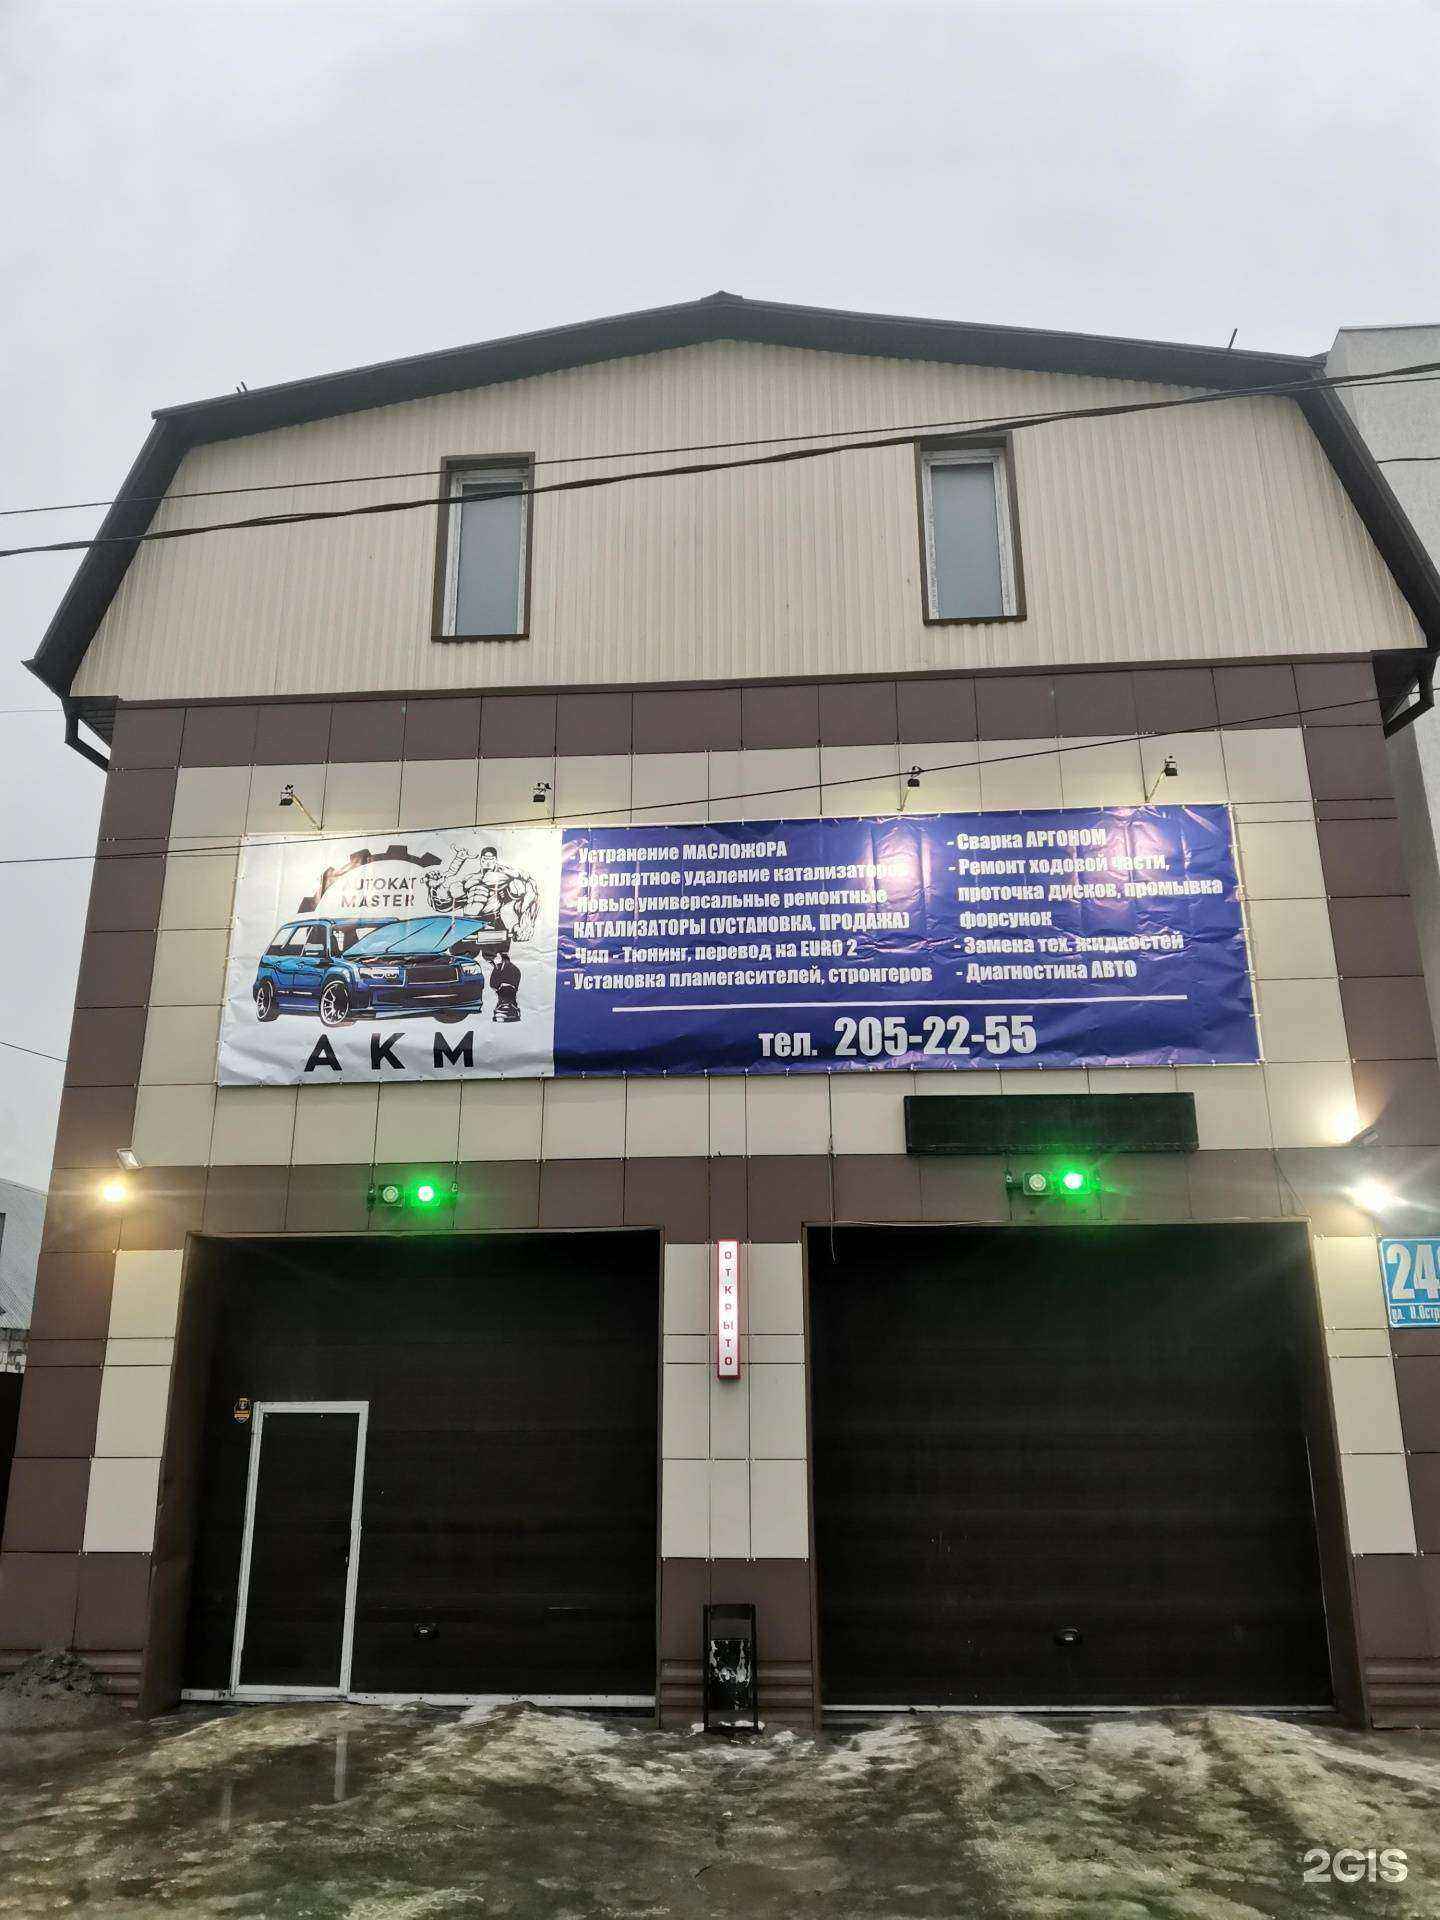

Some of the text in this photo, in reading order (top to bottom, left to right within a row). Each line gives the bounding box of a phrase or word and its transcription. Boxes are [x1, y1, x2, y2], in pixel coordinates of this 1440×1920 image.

[957, 833, 1023, 850] Сварка
[1026, 828, 1106, 847] АРГОНОМ
[578, 847, 679, 863] Устранение
[682, 841, 787, 860] МАСЛОЖОРА
[958, 858, 1026, 875] Ремонт
[1029, 853, 1108, 875] ходовой
[1114, 854, 1170, 871] части,
[684, 866, 770, 886] удаление
[341, 894, 415, 908] MASTER
[577, 896, 635, 913] Новые
[637, 890, 780, 912] универсальные
[784, 889, 888, 909] ремонтные
[958, 879, 1223, 902] проточка дисков, промывка
[573, 911, 911, 939] КАТАЛИЗАТОРЫ (УСТАНОВКА, ПРОДАЖА)
[960, 911, 1053, 930] форсунок
[575, 947, 609, 964] Чип
[622, 946, 692, 963] Тюнинг,
[695, 944, 773, 961] перевод
[776, 942, 797, 957] на
[800, 939, 843, 957] EURO
[846, 938, 858, 956] 2
[964, 937, 1035, 954] Замена
[1037, 937, 1073, 952] тех.
[1076, 931, 1184, 953] жидкостей
[573, 971, 666, 990] Установка
[669, 965, 825, 988] пламегасителей,
[828, 966, 933, 985] стронгеров
[966, 962, 1088, 983] Диагностика
[1091, 959, 1137, 979] АВТО
[758, 1015, 1037, 1057] тел. 205-22-55
[1386, 1243, 1440, 1299] 24
[723, 1251, 734, 1366] ОТКРЫТО
